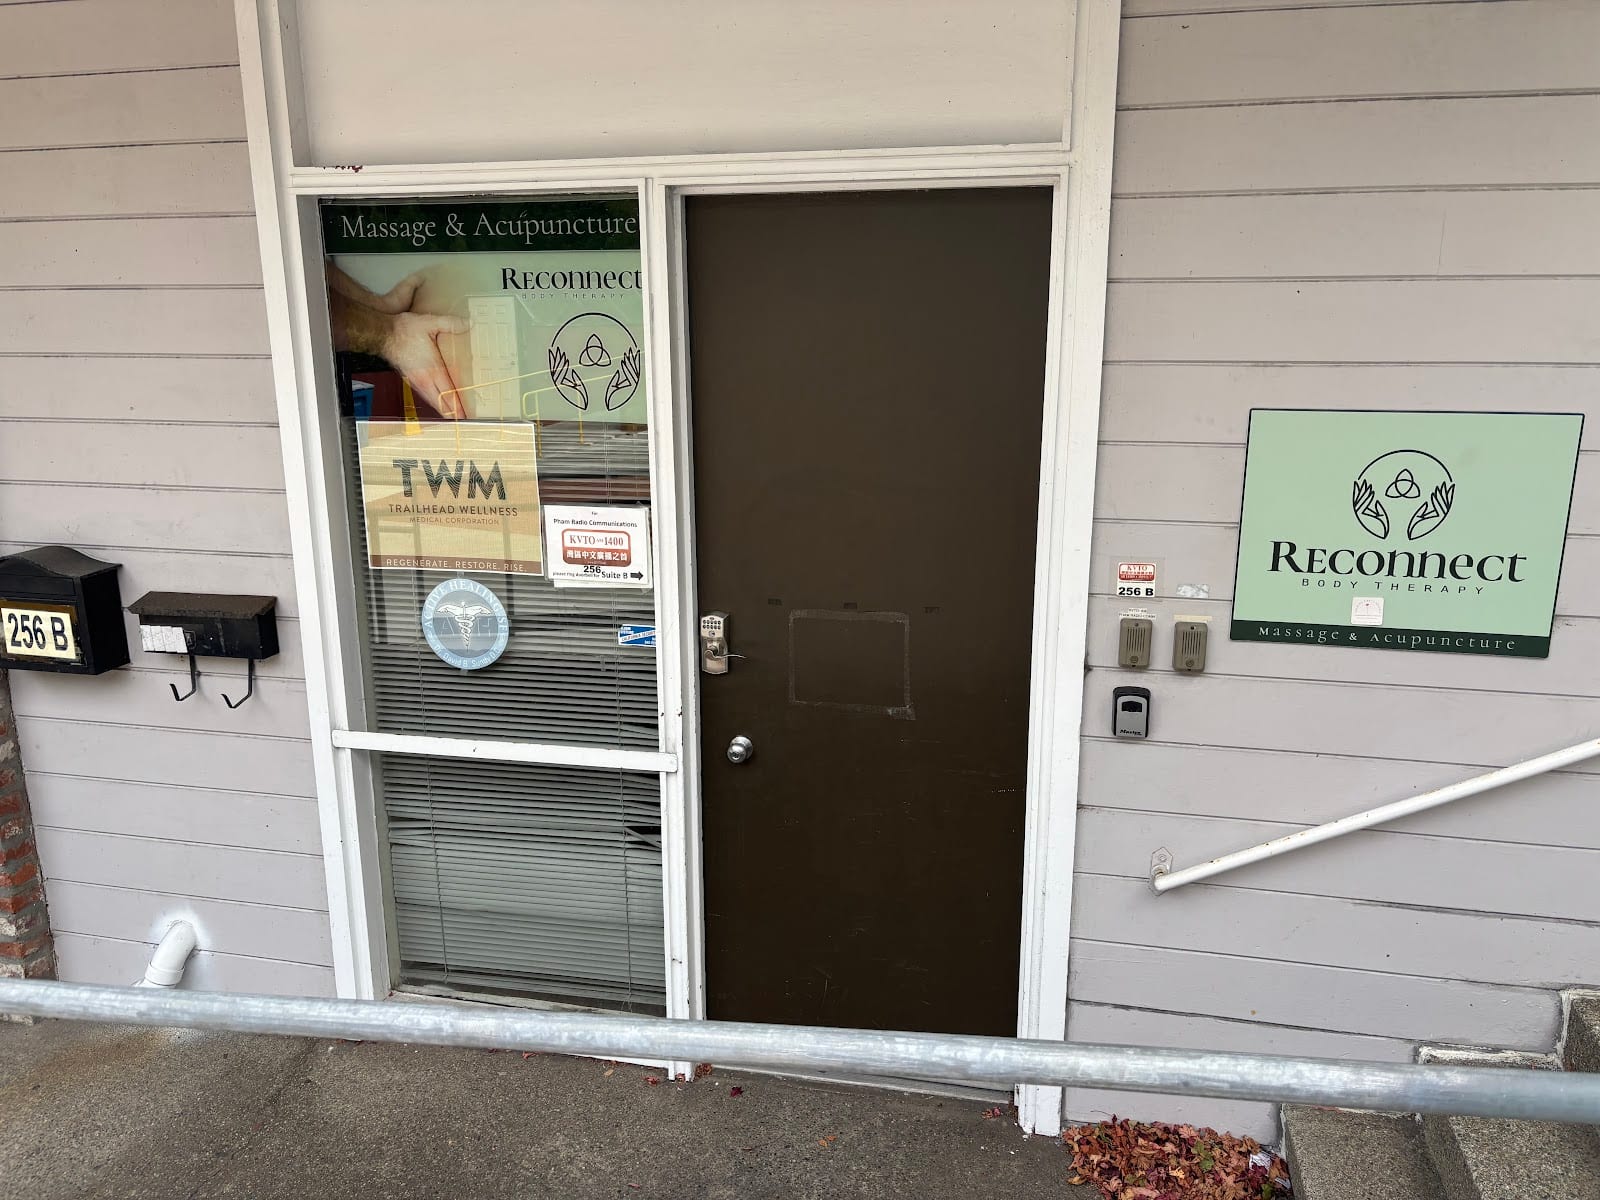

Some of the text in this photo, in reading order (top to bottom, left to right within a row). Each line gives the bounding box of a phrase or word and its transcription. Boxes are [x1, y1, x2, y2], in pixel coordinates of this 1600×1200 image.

[341, 211, 638, 246] Massage & Acupuncture
[563, 292, 626, 300] THERAPY
[392, 459, 506, 501] TWM
[388, 503, 518, 517] TRAILHEAD WELLNESS
[409, 516, 499, 526] MEDICAL CORPORATION
[588, 519, 638, 528] Communications
[569, 534, 596, 545] KVTO
[604, 536, 624, 546] 1400
[386, 558, 527, 572] REGENERATE. RESTORE. RISE.
[583, 565, 602, 574] 256
[601, 571, 621, 579] Suite
[1118, 587, 1154, 596] 256 B
[1301, 578, 1485, 595] BODY THERAPY
[449, 580, 501, 613] HEALING
[7, 612, 69, 651] 256 B
[1258, 626, 1516, 650] Massage & Acupuncture
